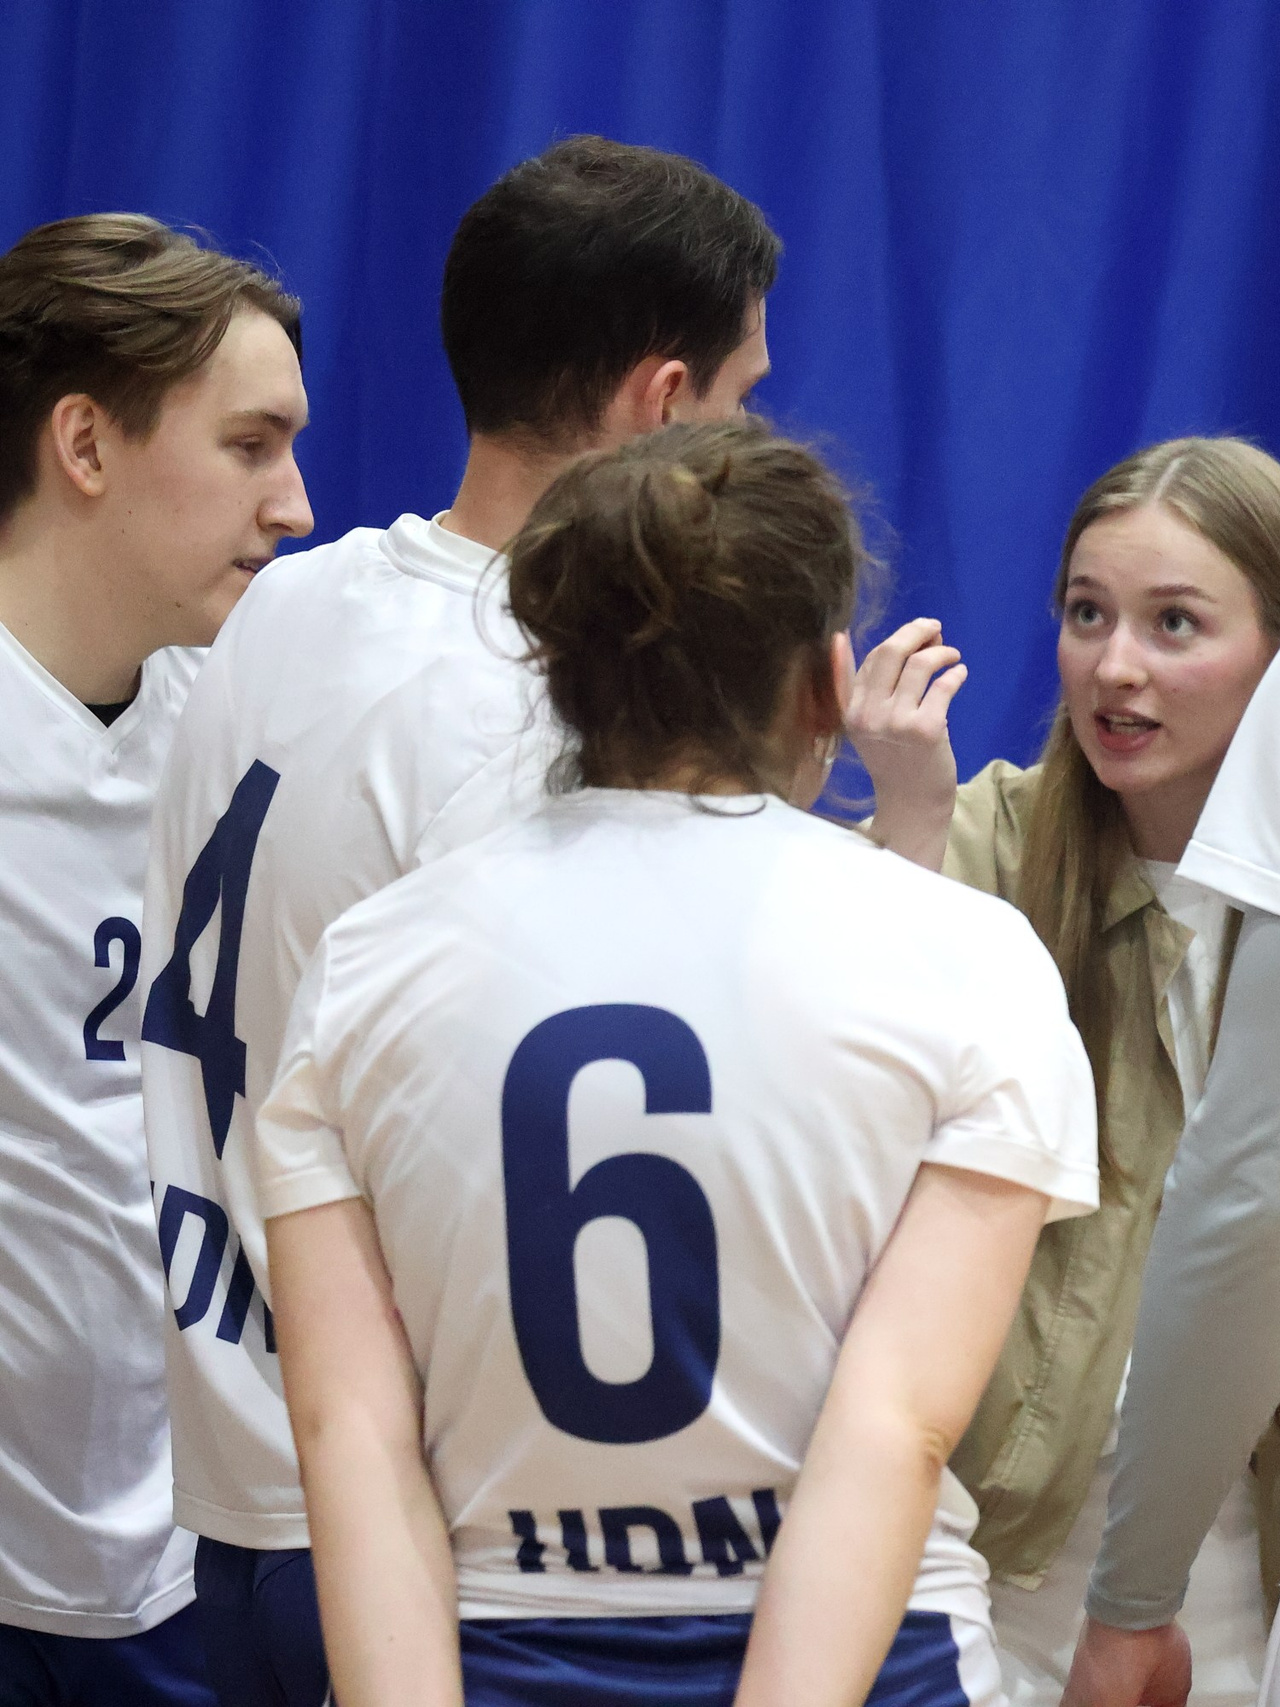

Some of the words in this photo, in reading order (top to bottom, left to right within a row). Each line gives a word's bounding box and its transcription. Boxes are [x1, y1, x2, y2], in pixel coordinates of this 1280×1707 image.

[83, 916, 142, 1062] 2
[141, 758, 281, 1160] 4
[501, 1003, 721, 1445] 6
